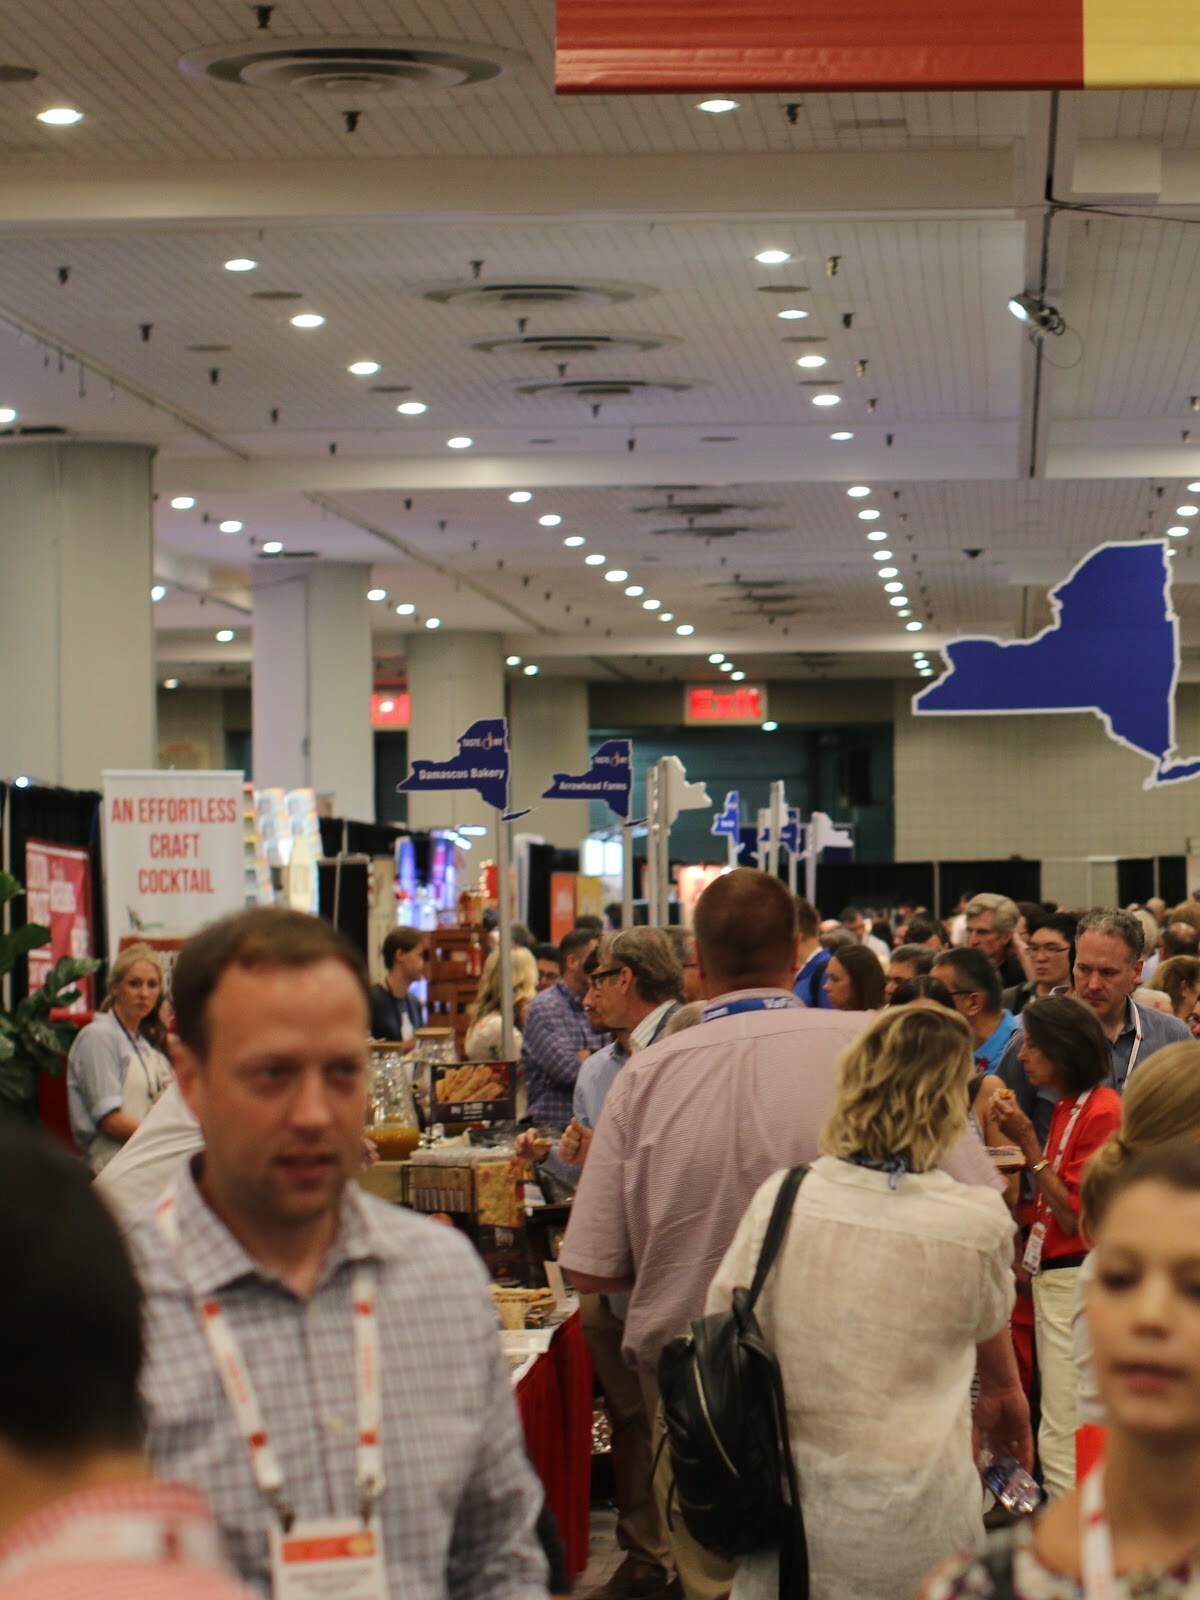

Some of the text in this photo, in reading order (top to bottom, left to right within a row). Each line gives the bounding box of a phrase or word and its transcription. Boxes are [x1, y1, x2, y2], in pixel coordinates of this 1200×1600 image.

[690, 688, 762, 719] Exit
[419, 768, 505, 780] Damascus Bakery
[559, 781, 628, 791] Arrowhead Farms
[112, 798, 237, 823] AN EFFORTLESS
[150, 833, 200, 858] CRAFT
[138, 869, 214, 894] COCKTAIL
